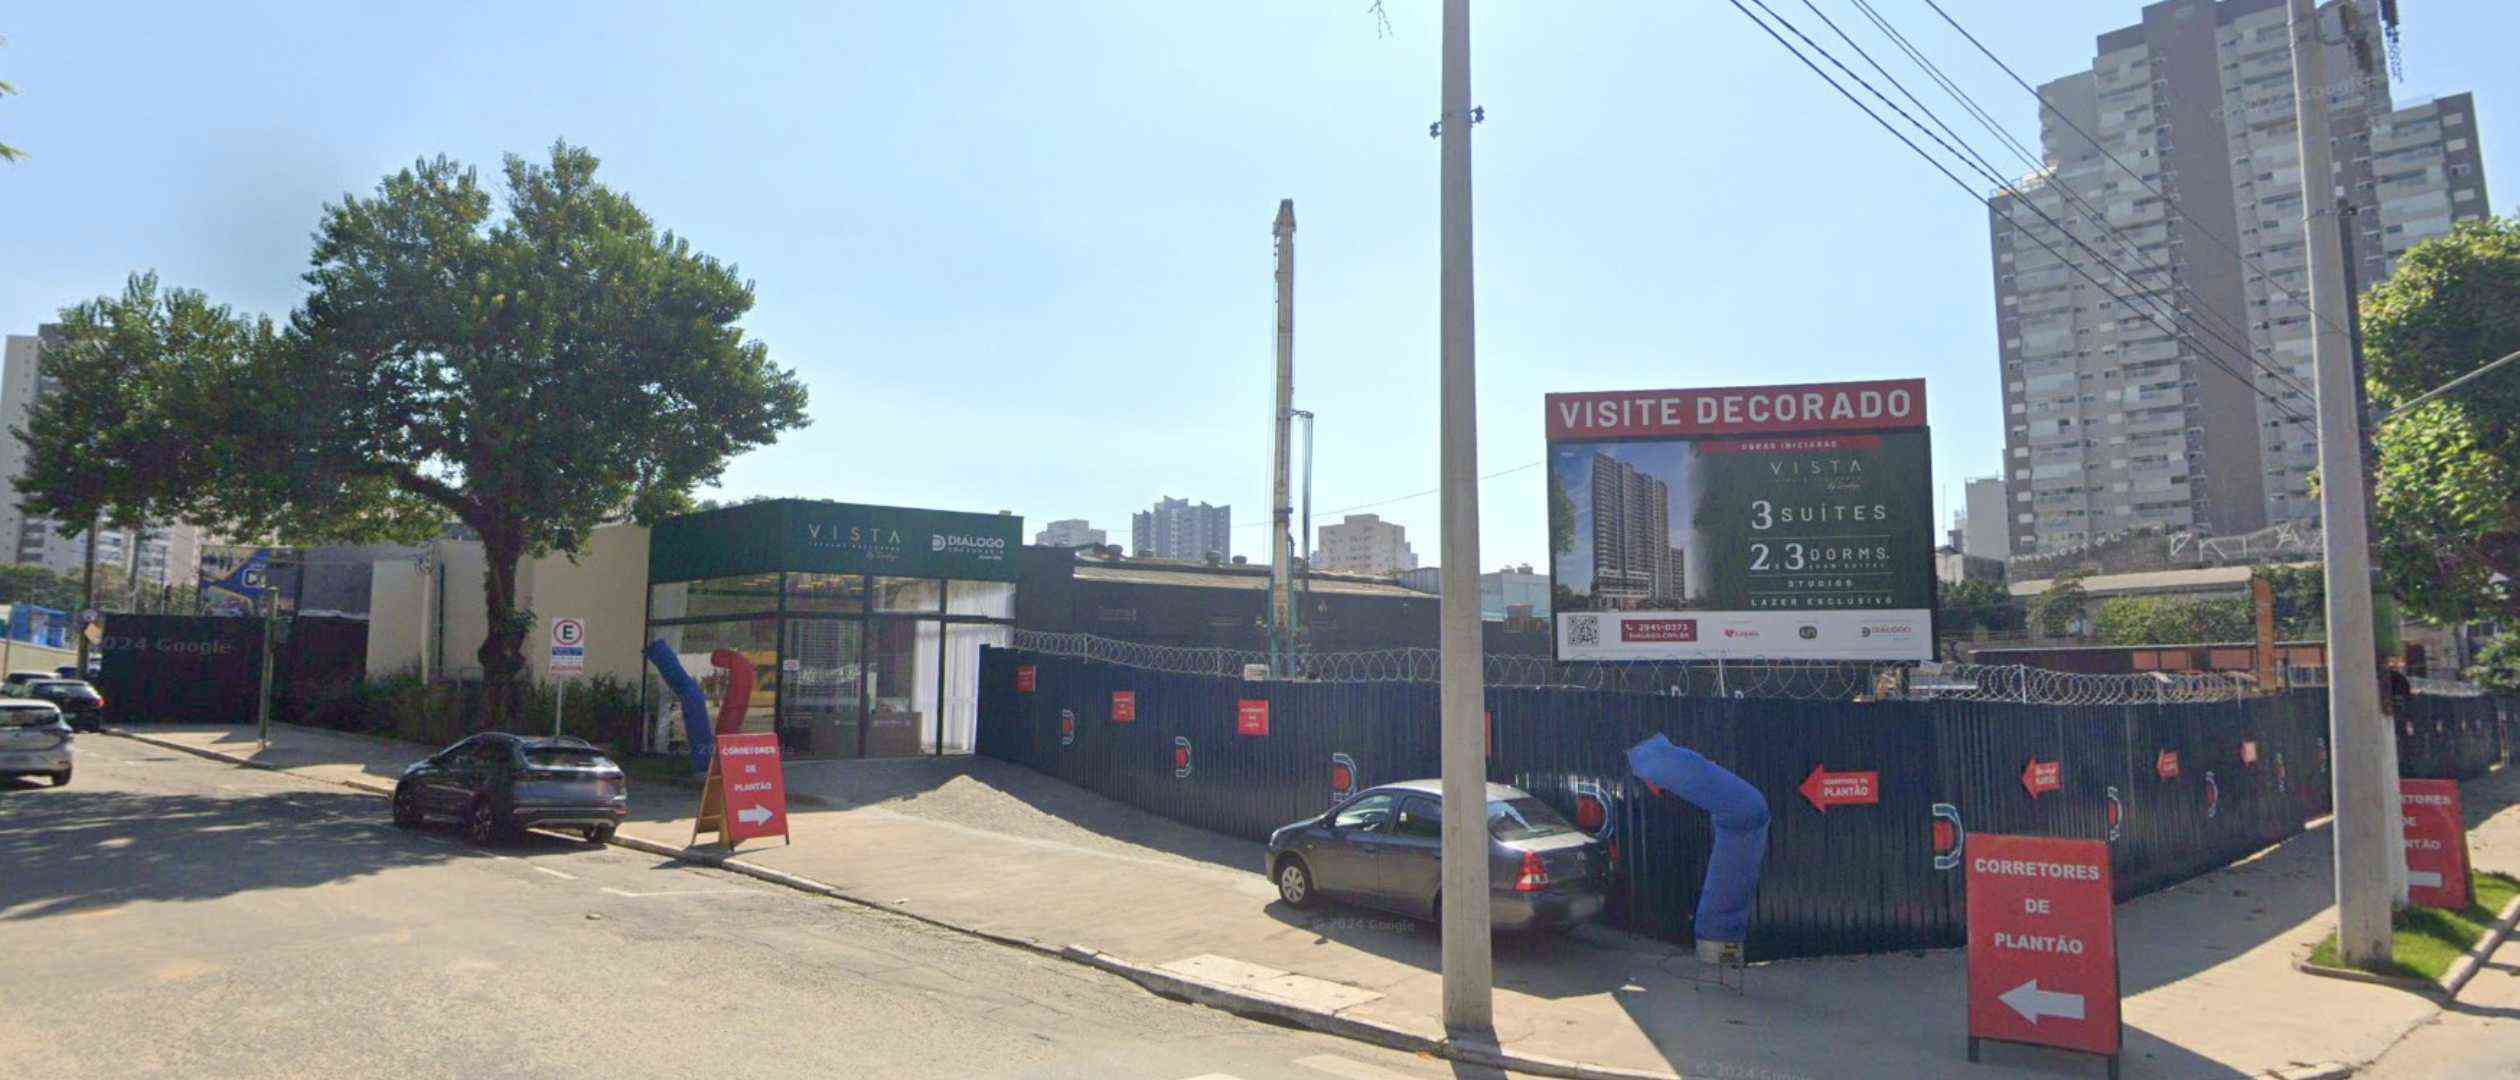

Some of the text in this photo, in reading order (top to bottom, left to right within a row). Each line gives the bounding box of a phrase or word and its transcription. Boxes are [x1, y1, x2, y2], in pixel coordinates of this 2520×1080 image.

[1559, 389, 1911, 429] VISITE DECORADO
[1769, 459, 1862, 475] VISTA
[1751, 500, 1773, 530] 3
[808, 523, 901, 543] VISTA
[562, 624, 575, 641] E
[1974, 857, 2100, 881] CORRETORES
[2025, 898, 2050, 914] DE
[1994, 932, 2084, 954] PLANTÃO
